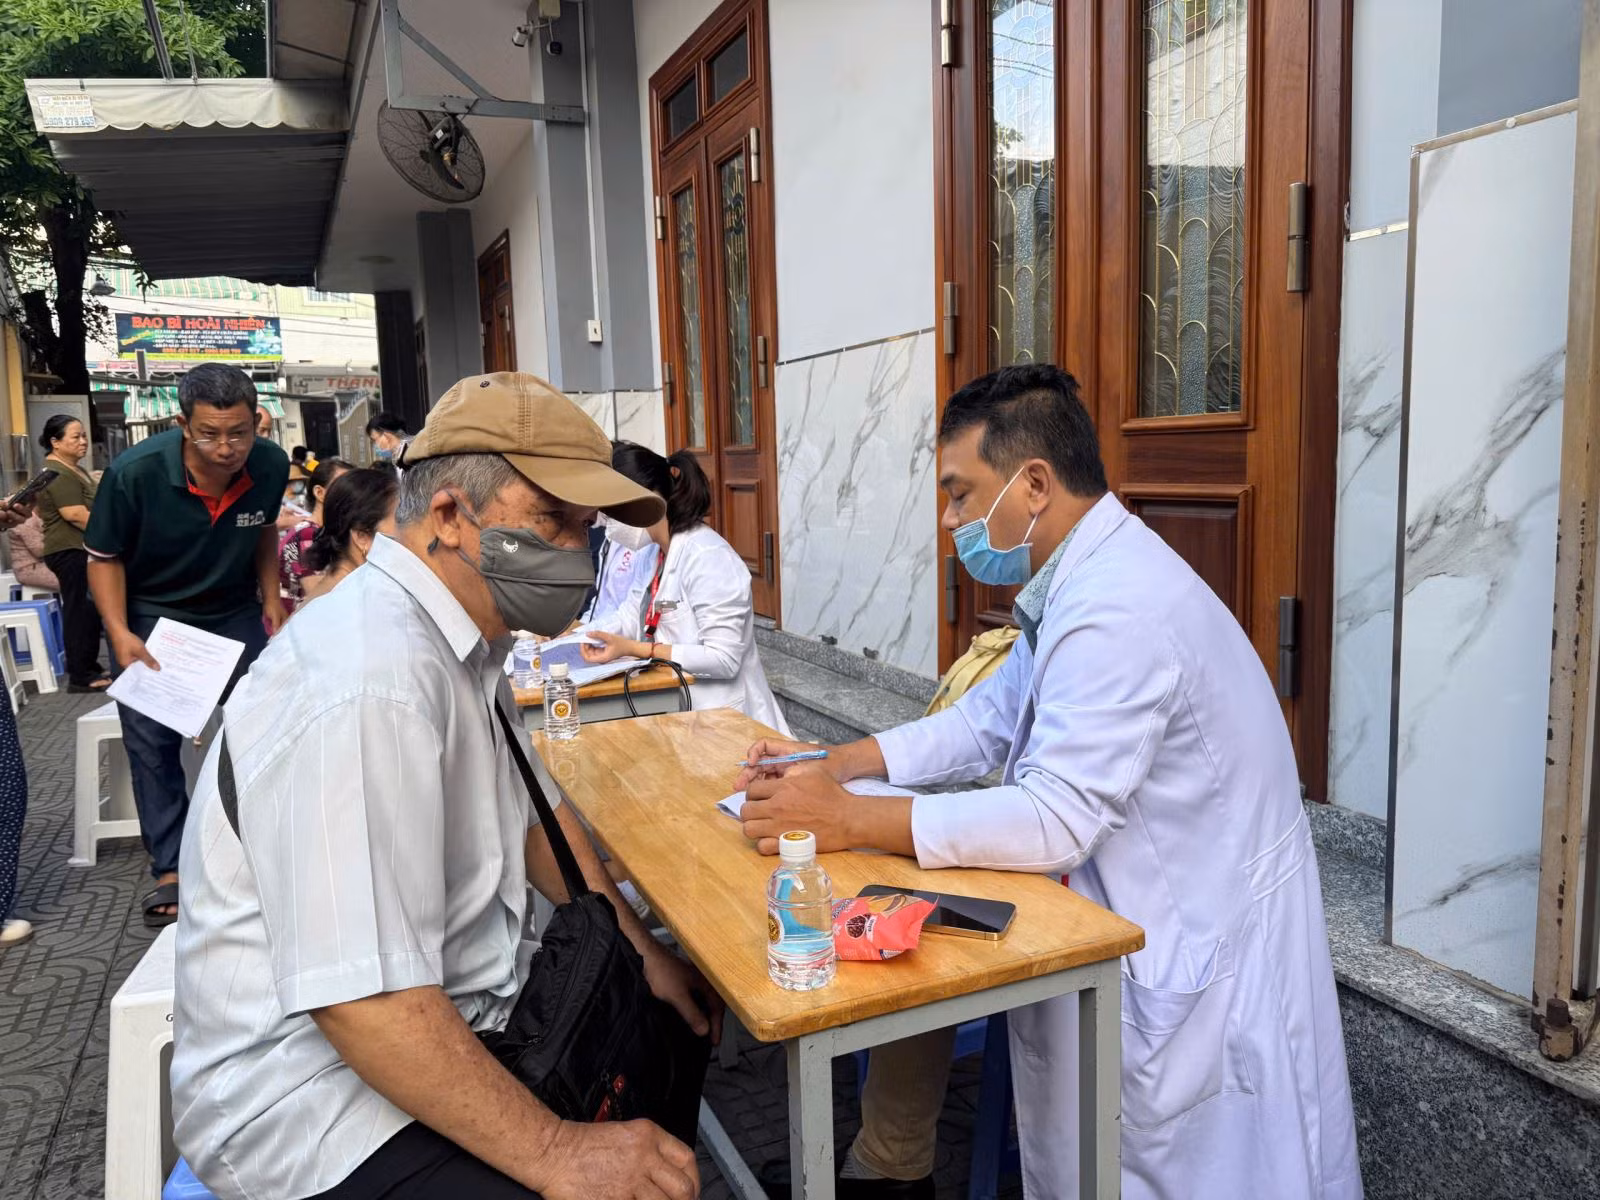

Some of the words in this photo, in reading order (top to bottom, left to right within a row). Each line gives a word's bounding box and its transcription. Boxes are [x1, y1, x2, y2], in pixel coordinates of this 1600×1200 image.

[132, 317, 163, 328] BAO
[167, 316, 182, 329] BÌ
[185, 316, 221, 329] HOÀI
